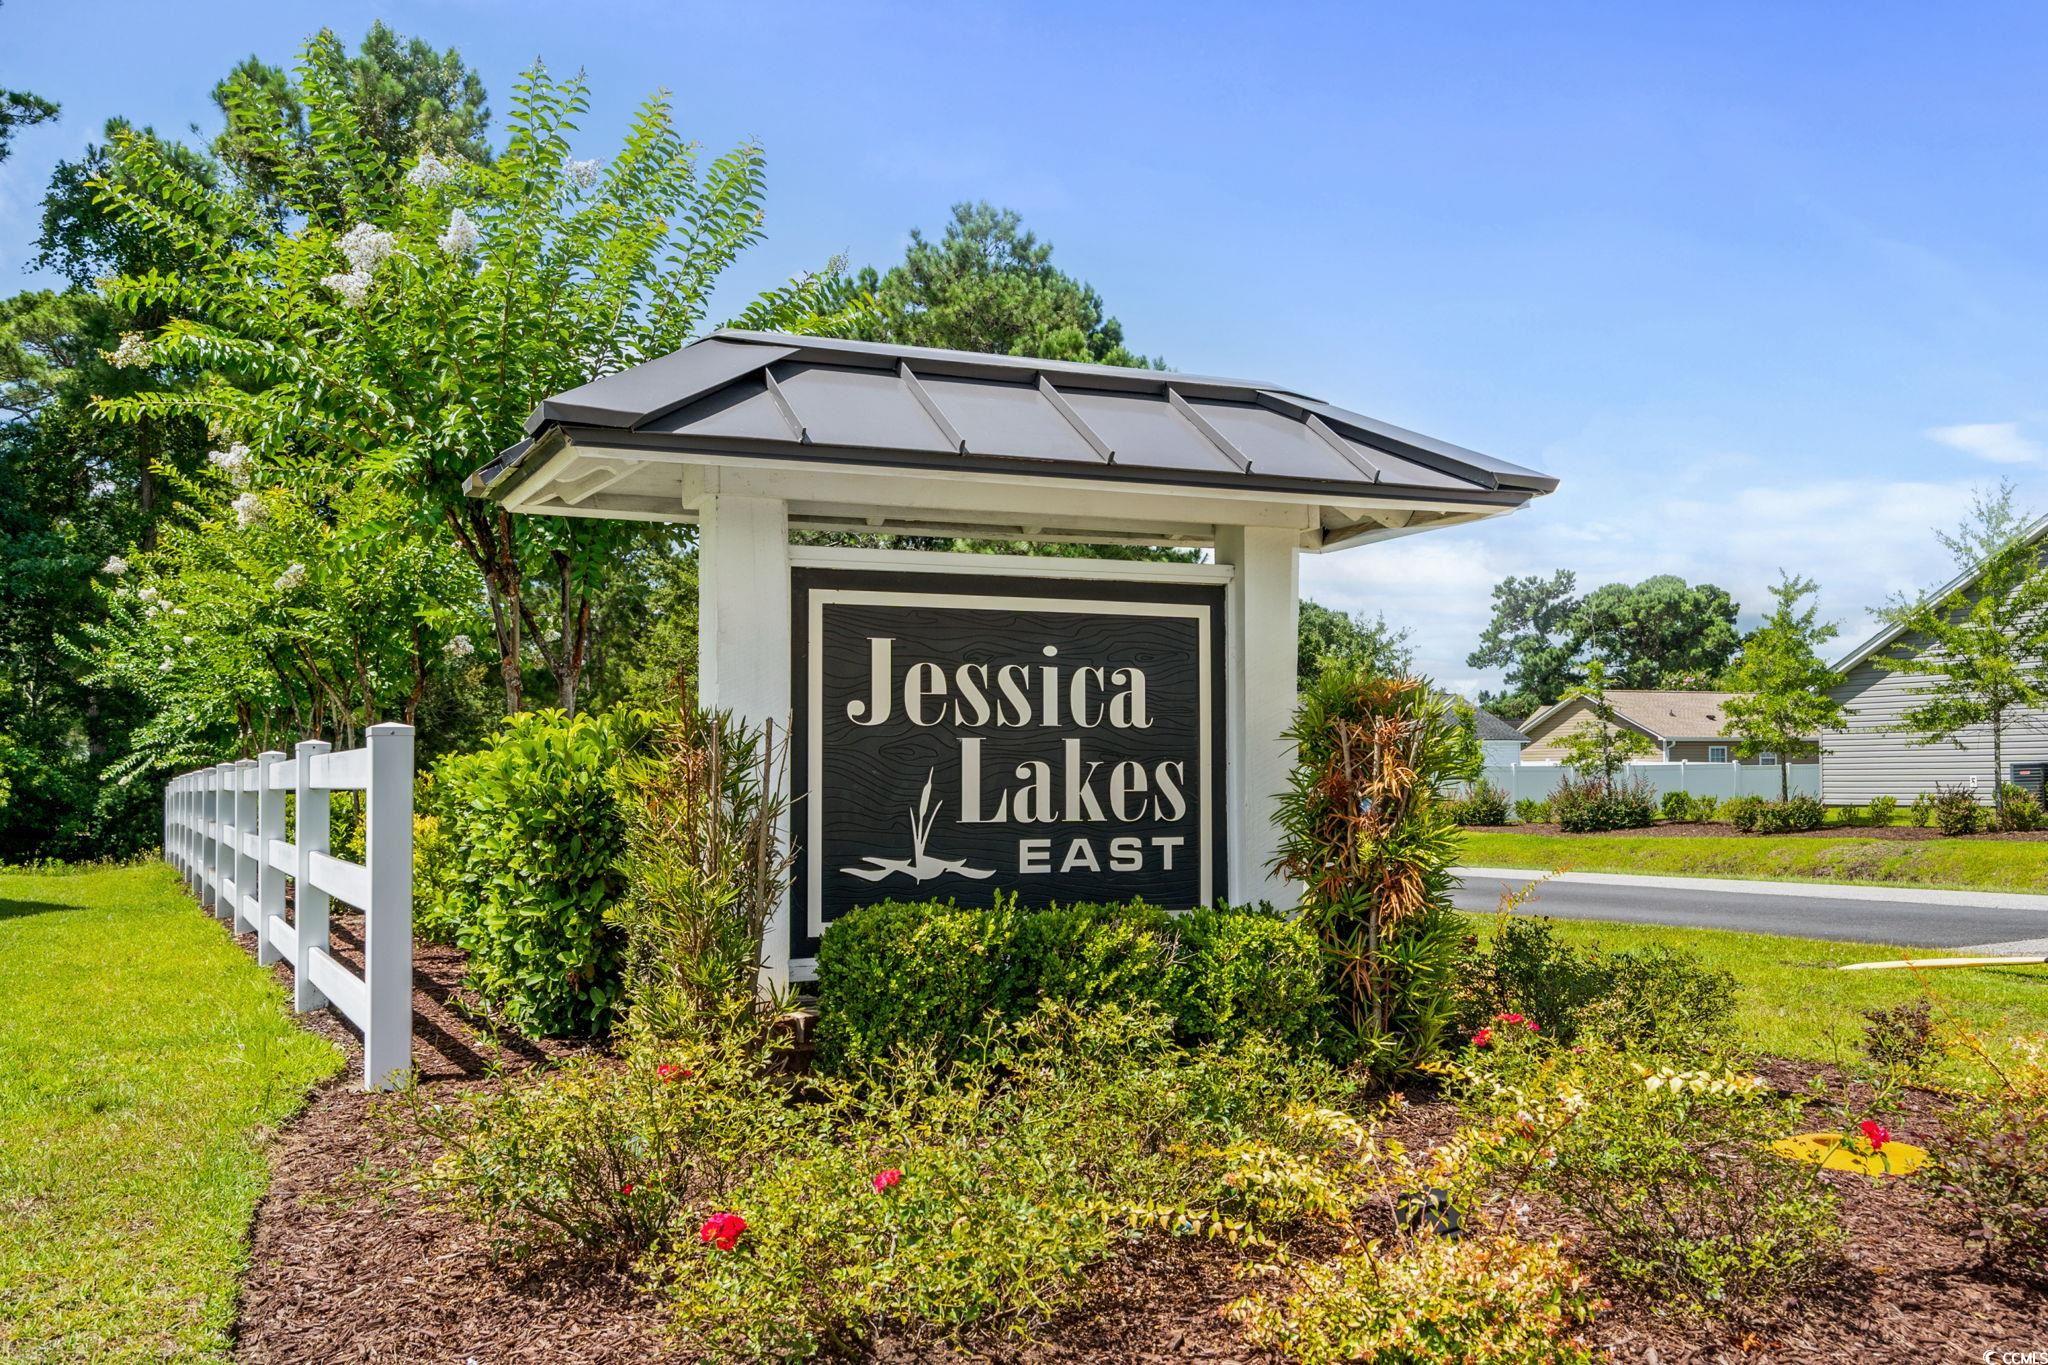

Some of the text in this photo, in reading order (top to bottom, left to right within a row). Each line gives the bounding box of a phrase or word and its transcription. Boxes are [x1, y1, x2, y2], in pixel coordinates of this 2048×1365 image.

[846, 637, 1154, 728] Jessica
[956, 737, 1186, 823] Lakes
[1019, 836, 1185, 873] EAST
